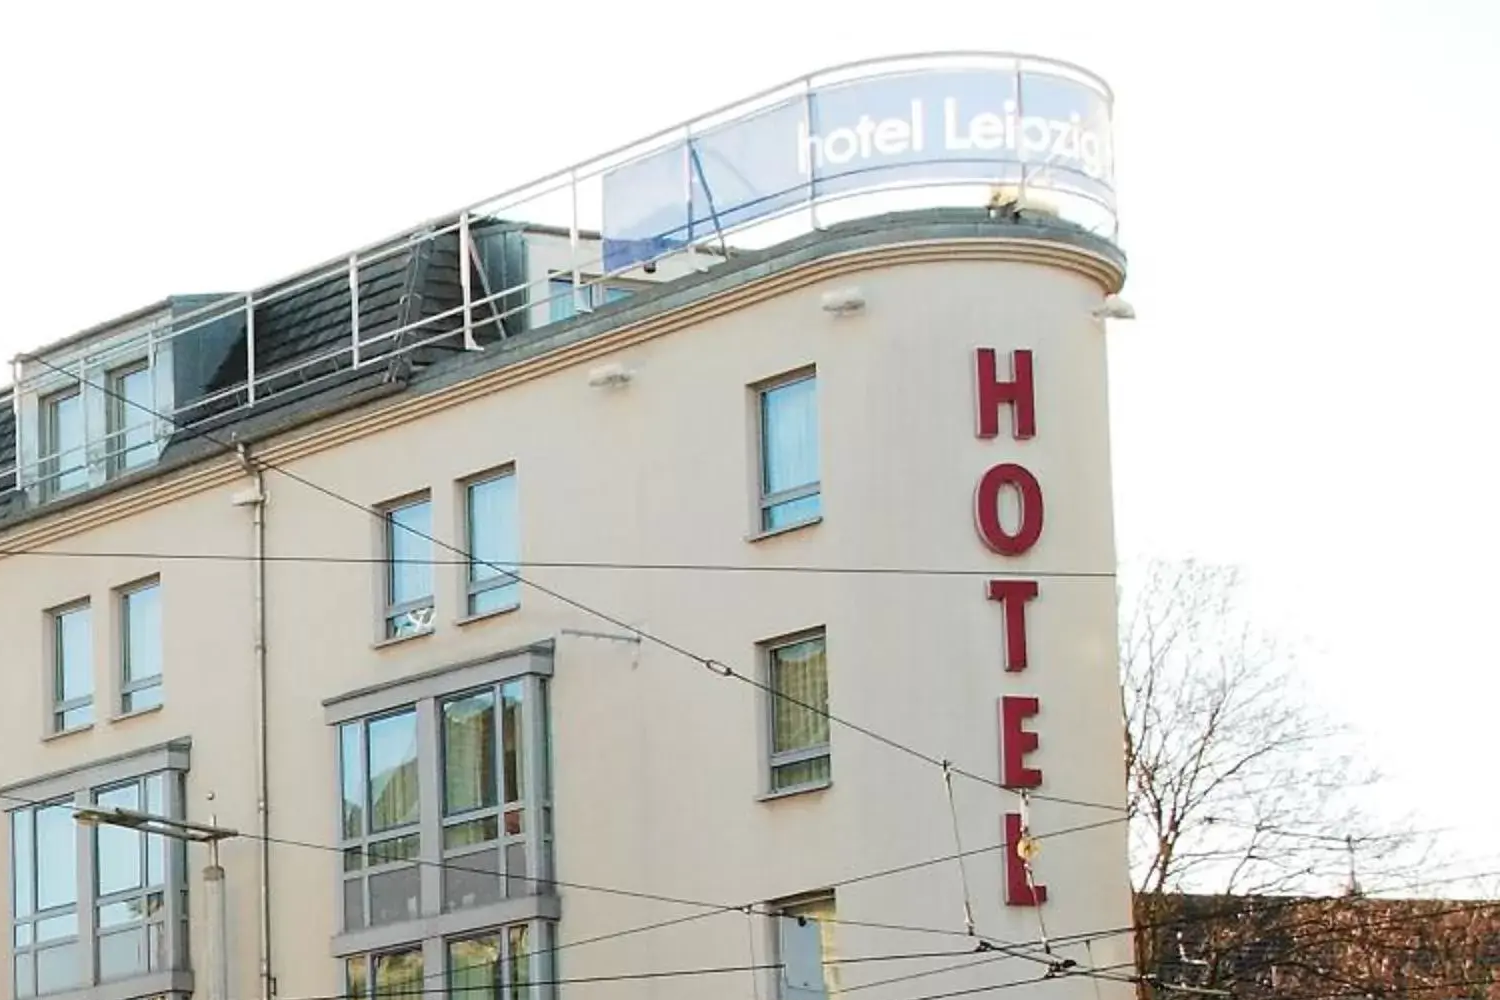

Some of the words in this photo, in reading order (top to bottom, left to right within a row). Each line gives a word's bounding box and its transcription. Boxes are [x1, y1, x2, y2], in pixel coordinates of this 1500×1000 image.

[796, 97, 924, 175] hotel
[943, 97, 1103, 178] Leipzig
[972, 346, 1048, 907] HOTEL
